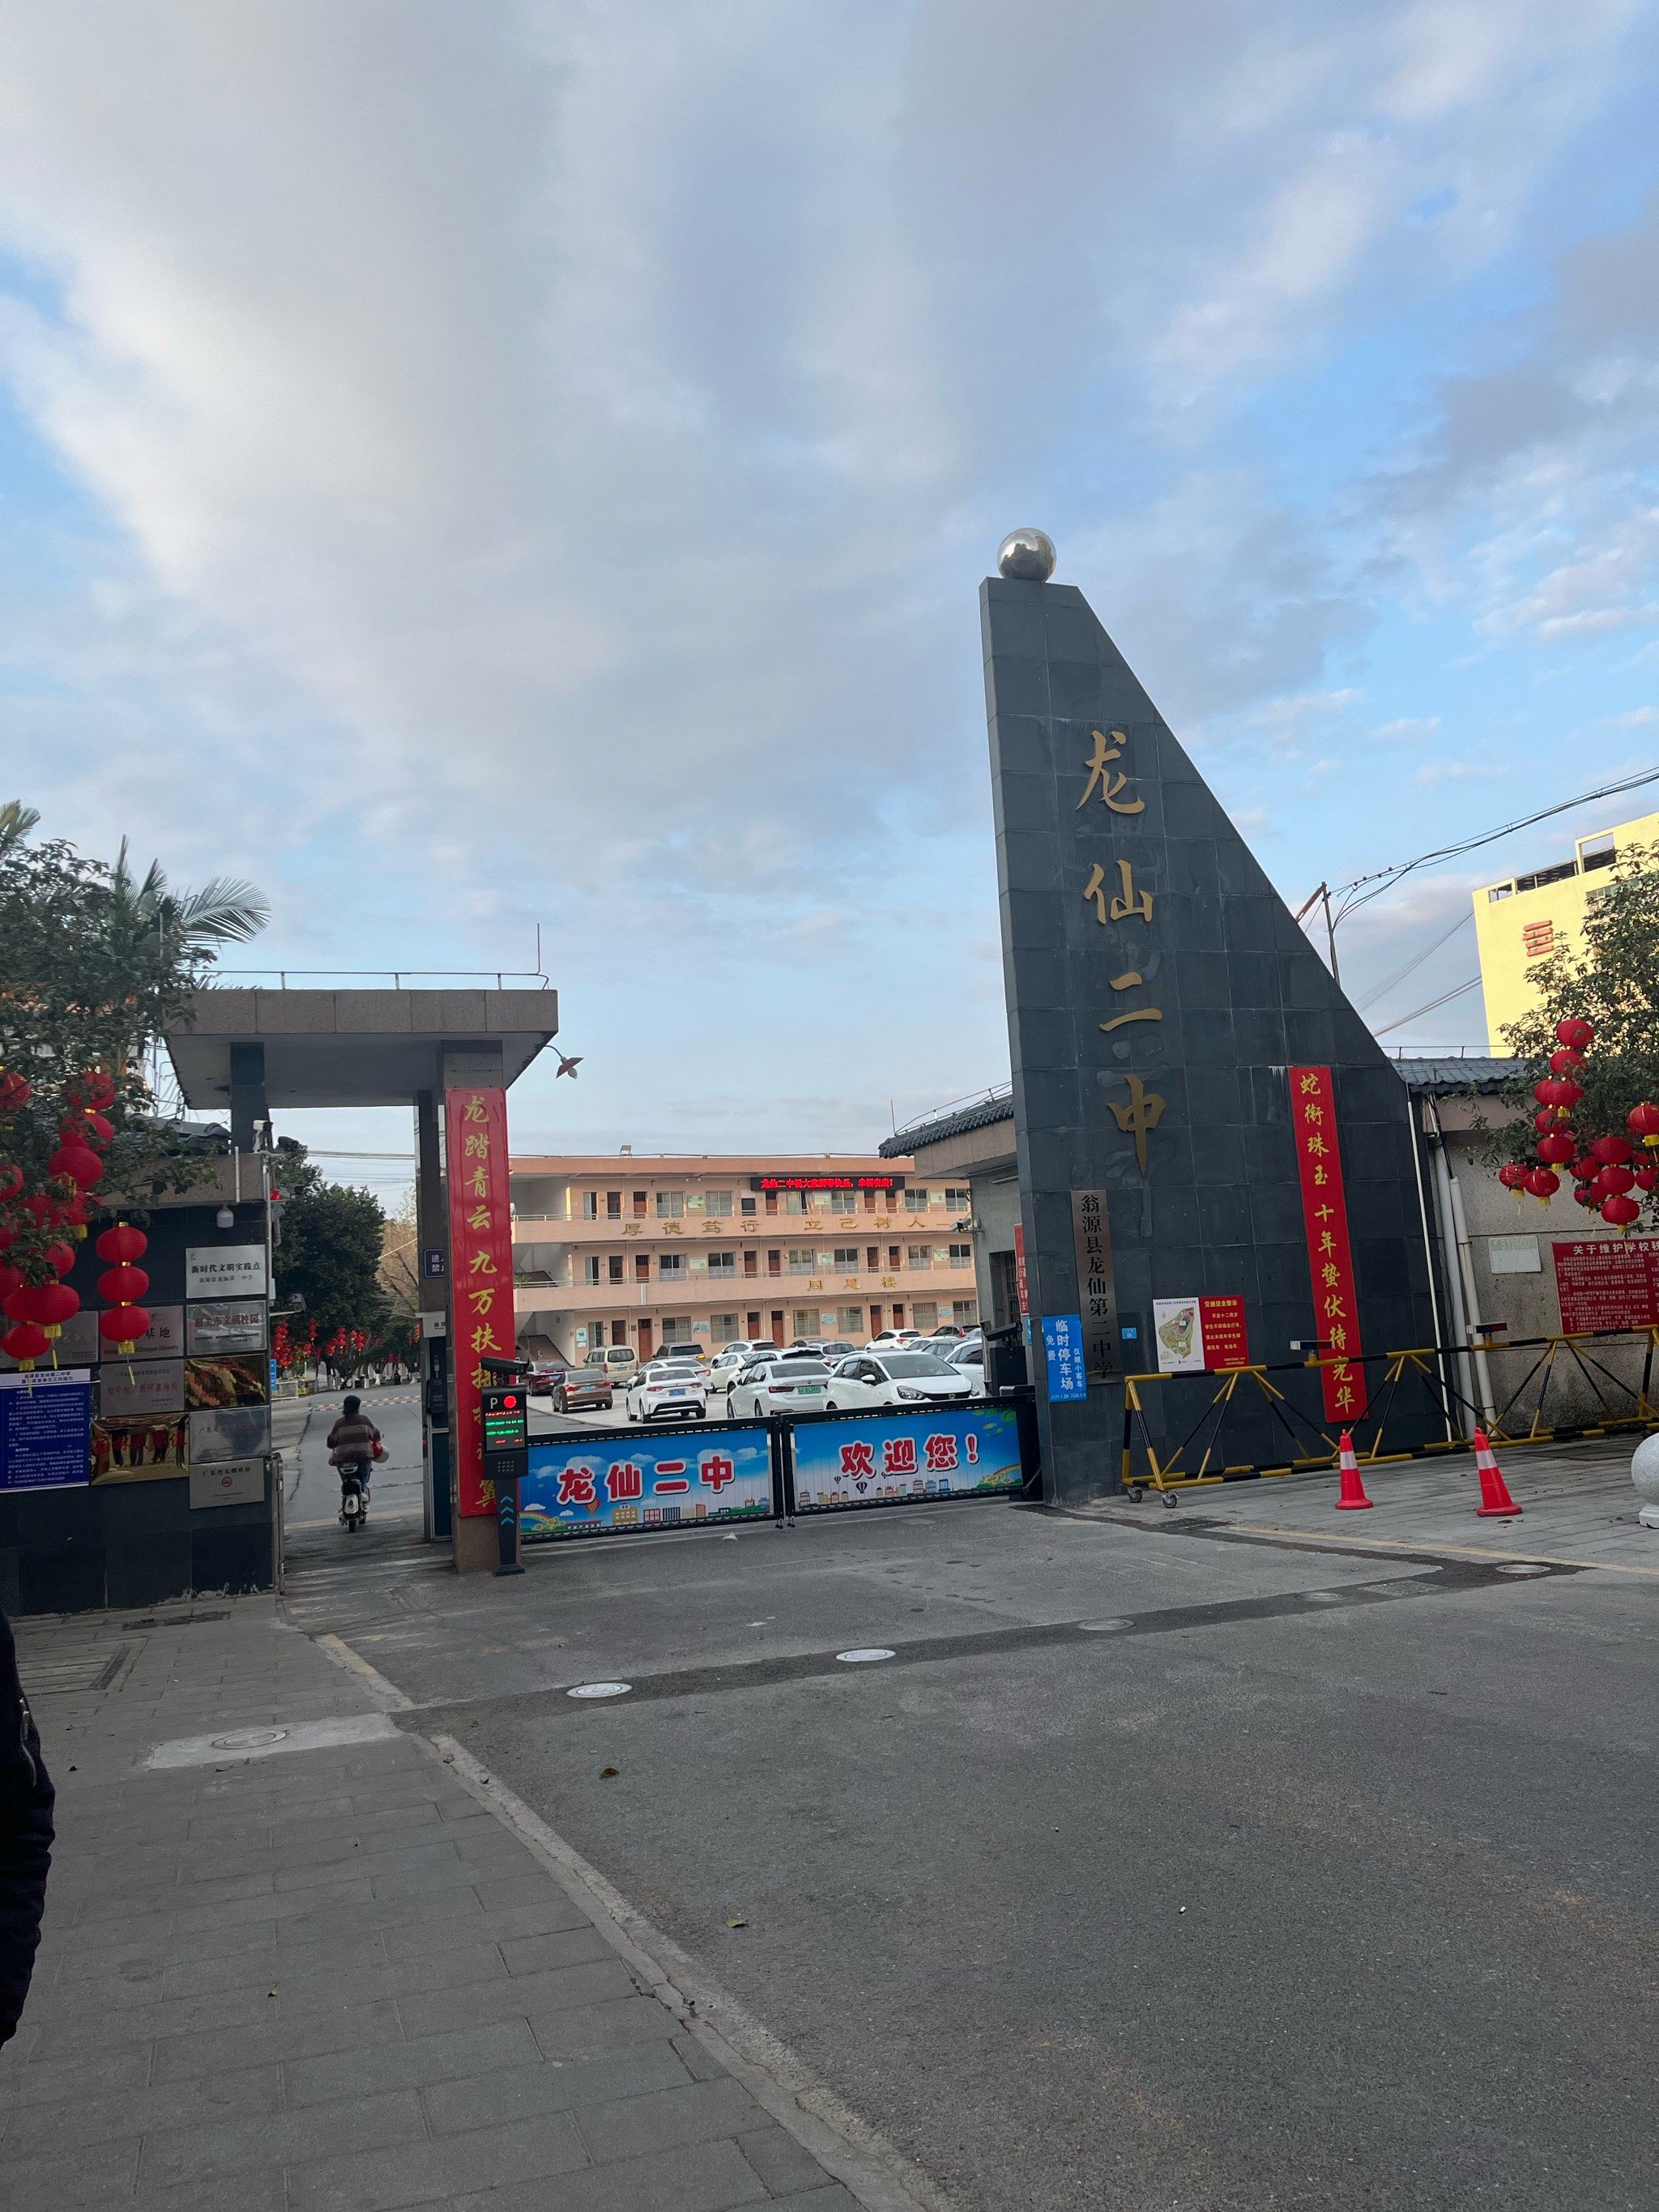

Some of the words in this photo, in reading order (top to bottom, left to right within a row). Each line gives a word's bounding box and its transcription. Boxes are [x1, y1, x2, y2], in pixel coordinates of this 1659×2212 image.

[1076, 729, 1166, 1177] 龙仙二中
[463, 1095, 491, 1230] 龙踏青云
[621, 1219, 760, 1236] 厚德笃行
[804, 1215, 926, 1231] 立己树人
[191, 1262, 261, 1274] 新时代文明实践点
[1080, 1194, 1115, 1380] 翁源县龙仙第二中学
[1205, 1300, 1238, 1308] 交通安全警示
[1046, 1334, 1056, 1361] 免费
[1056, 1319, 1074, 1390] 临时停车场
[1073, 1348, 1084, 1389] 仅限小客车
[490, 1398, 498, 1409] P
[840, 1434, 977, 1477] 欢迎您!
[558, 1455, 734, 1503] 龙仙二中
